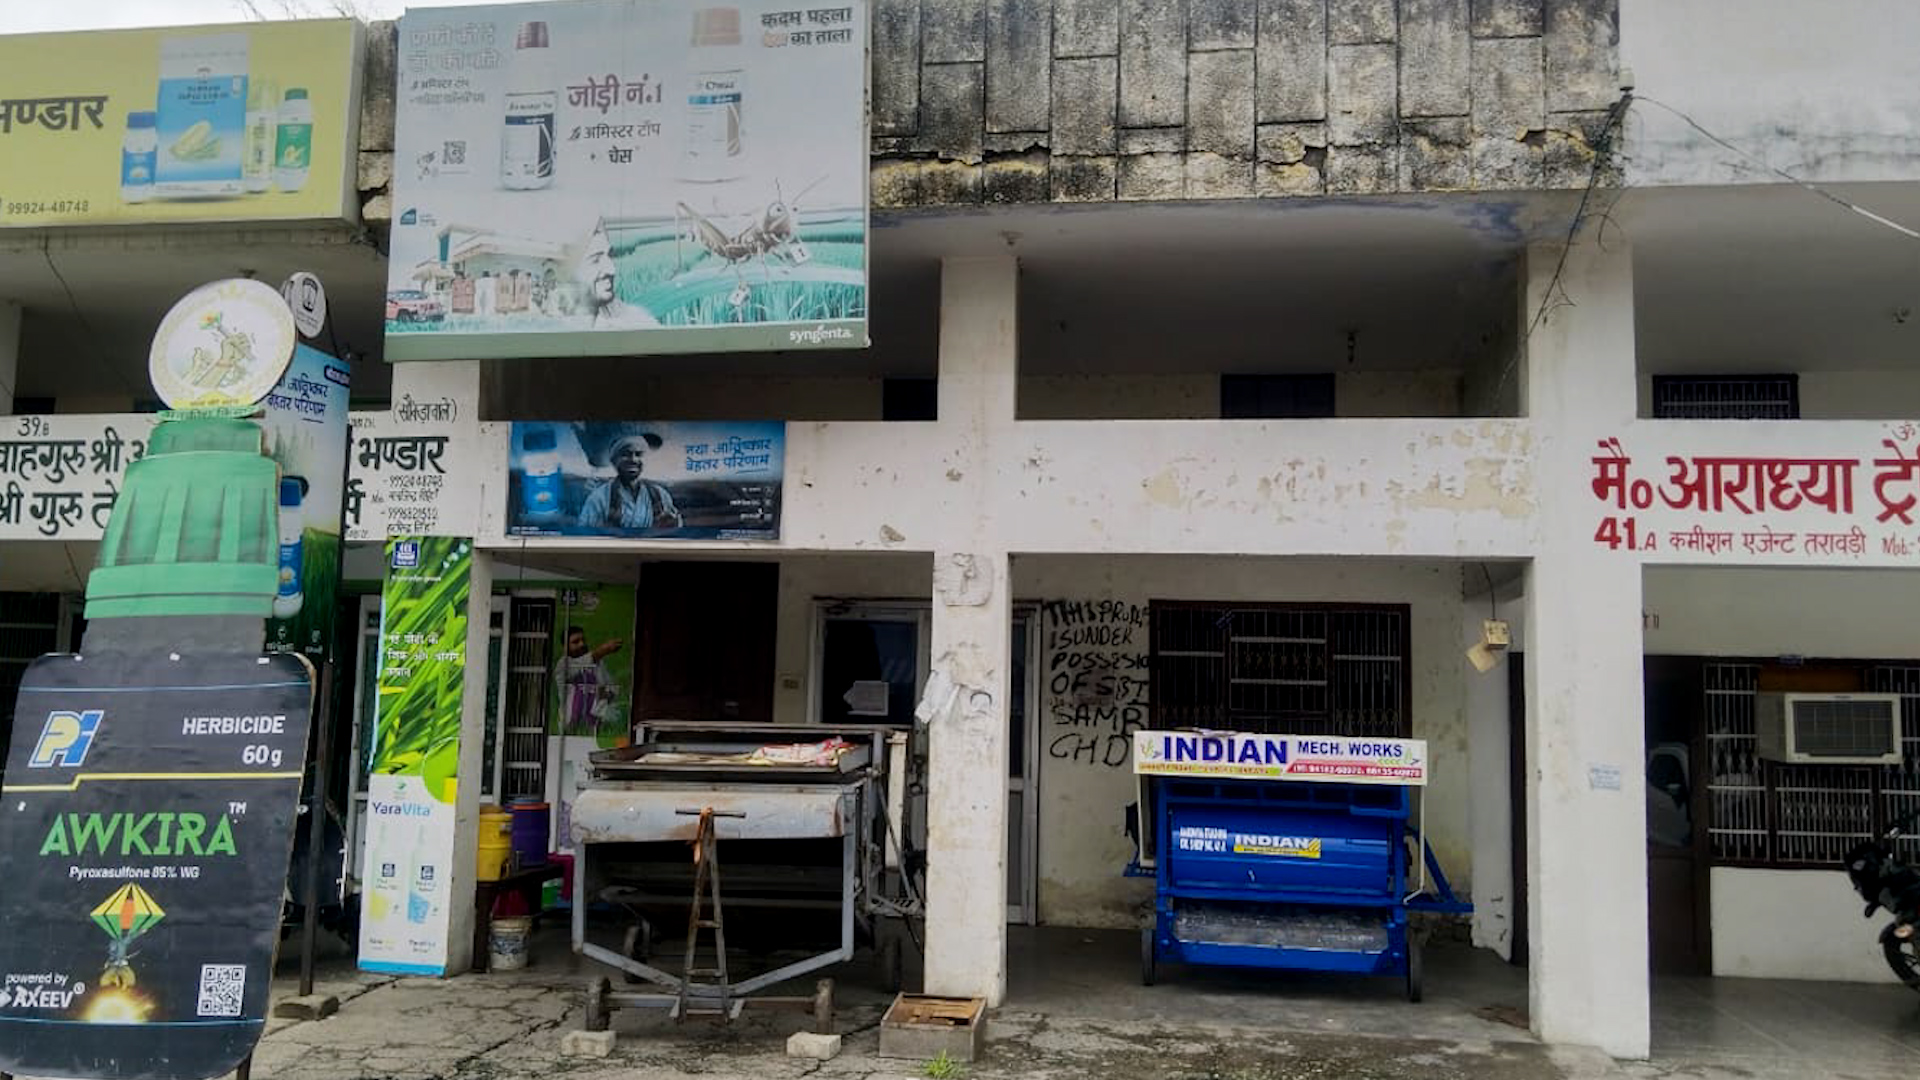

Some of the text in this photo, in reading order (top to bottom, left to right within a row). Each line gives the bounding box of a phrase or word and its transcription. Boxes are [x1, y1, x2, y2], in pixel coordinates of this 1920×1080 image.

[566, 74, 622, 114] जोड़ी
[583, 123, 634, 139] अमिस्टर
[90, 427, 124, 474] श्री
[359, 436, 450, 474] भण्डार
[1658, 455, 1860, 515] आराध्या
[1873, 438, 1920, 525] ट्रे
[1668, 526, 1733, 555] कमीशन
[182, 715, 286, 736] HERBICIDE
[1163, 736, 1403, 765] INDIAN MECH. WORKS
[372, 801, 431, 818] YaraVita
[40, 811, 238, 857] AWKIRA
[1234, 834, 1309, 849] INDIAN
[69, 866, 151, 881] Pyroxasulfone
[180, 866, 200, 878] WG
[5, 971, 69, 987] powered by
